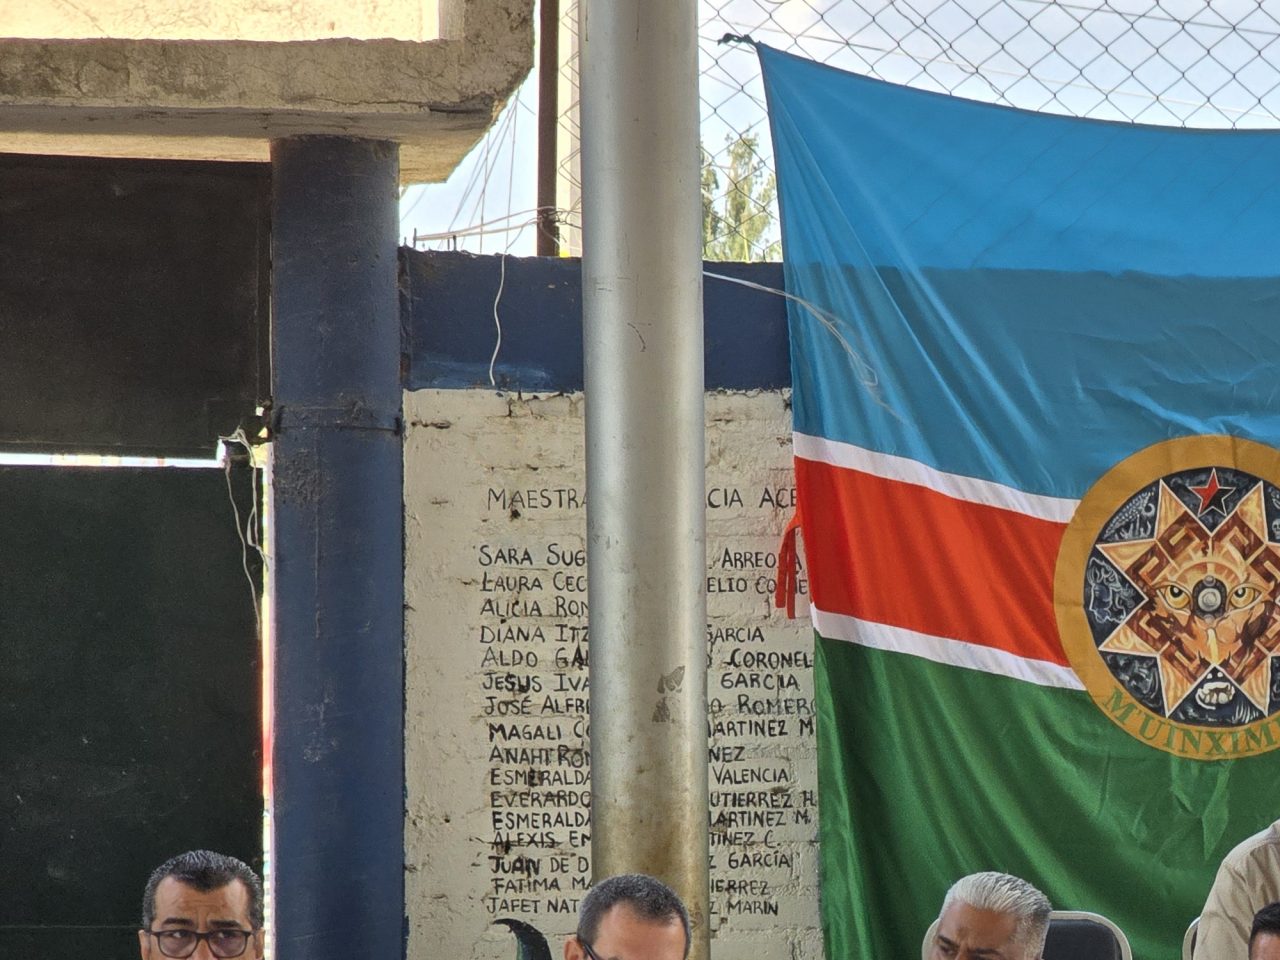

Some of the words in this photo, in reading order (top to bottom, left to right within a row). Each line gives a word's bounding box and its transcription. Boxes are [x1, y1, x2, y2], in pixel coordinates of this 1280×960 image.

[479, 545, 533, 566] SARA
[480, 571, 543, 592] LAURA
[553, 571, 587, 592] CEC
[480, 598, 543, 617] ALICIA
[480, 625, 546, 644] DIANA
[481, 646, 538, 668] ALDO
[488, 722, 562, 742] MAGALI
[708, 720, 788, 737] ARTINEZ
[712, 764, 789, 785] VALENCIA
[709, 810, 787, 828] ARTINEZ
[488, 855, 540, 878] JUAN
[550, 857, 569, 873] DE
[491, 877, 561, 895] FATIMA
[486, 897, 541, 914] JAFET
